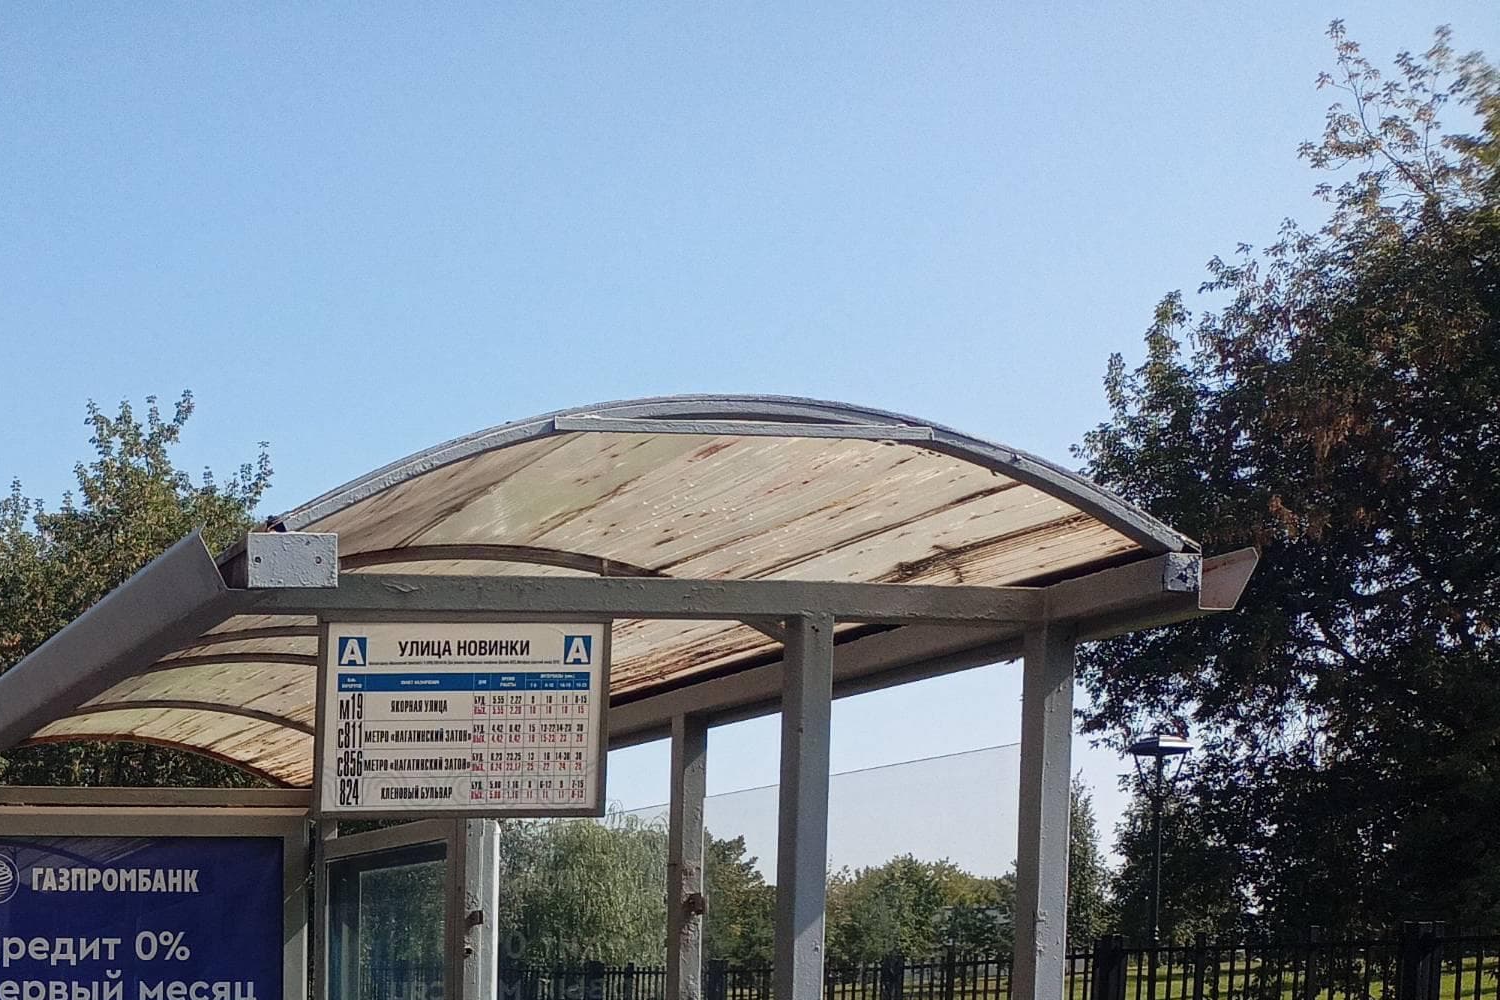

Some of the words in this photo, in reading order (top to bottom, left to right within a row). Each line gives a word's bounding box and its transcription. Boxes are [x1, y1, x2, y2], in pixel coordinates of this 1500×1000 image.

[340, 638, 365, 665] А
[398, 640, 452, 659] УЛИЦА
[457, 640, 530, 656] НОВИНКИ
[565, 637, 589, 662] А
[391, 700, 423, 712] ЯКОРНАЯ
[424, 700, 448, 714] УЛИЦА
[364, 731, 389, 743] МЕТРО
[391, 728, 444, 743] «НАГАТИНСКИЙ
[445, 730, 471, 742] ЗАТОН»
[364, 759, 388, 771] МЕТРО
[390, 757, 443, 771] «НАГАТИНСКИЙ
[444, 759, 470, 771] ЗАТОН»
[339, 778, 359, 805] 824
[380, 785, 419, 800] КЛЕНОВЫЙ
[420, 787, 452, 799] БУЛЬВАР
[32, 867, 200, 893] ГАЗПРОМБАНК
[135, 930, 190, 961] 0%
